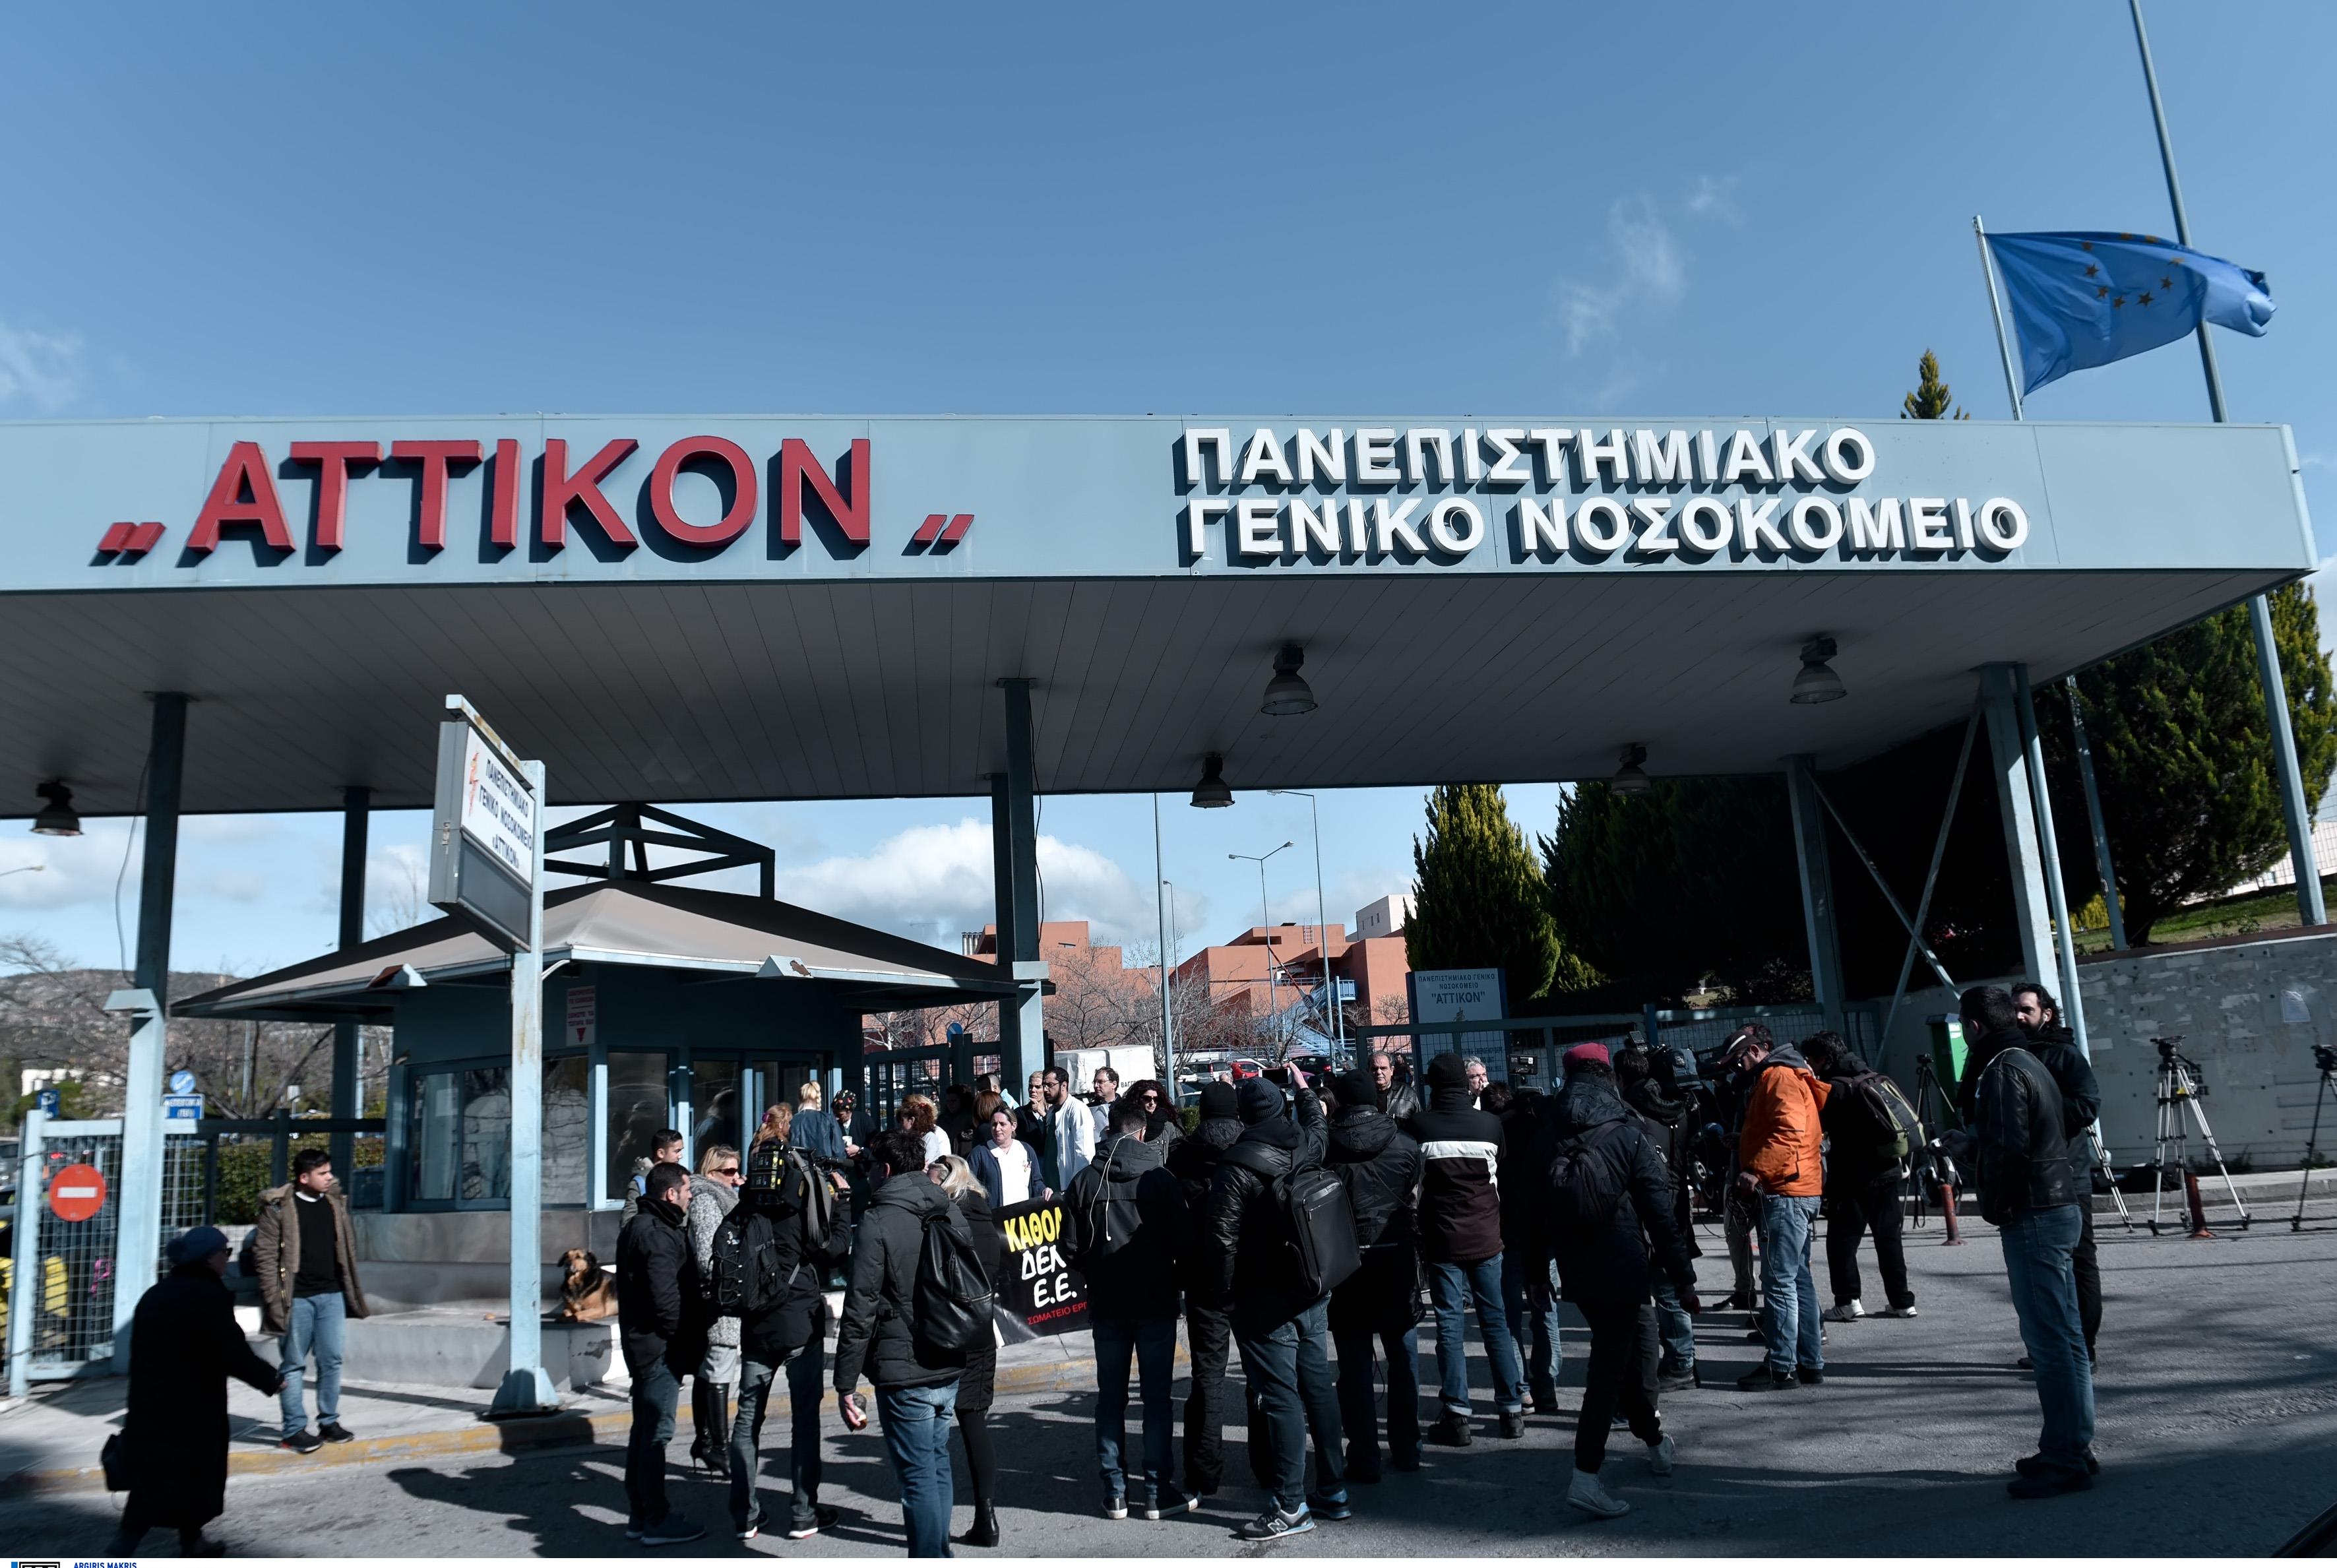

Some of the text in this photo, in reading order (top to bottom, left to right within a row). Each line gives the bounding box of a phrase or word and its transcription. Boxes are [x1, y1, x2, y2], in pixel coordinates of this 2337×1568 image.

[1185, 426, 1875, 485] ΠΑΝΕΠΙΣΤΗΜΙΑΚΟ
[1189, 497, 2030, 555] ΓΕΝΙΚΟ ΝΟΣΟΚΟΜΕΙΟ
[479, 784, 499, 819] ΓΕΝΙΚΟ
[1028, 1305, 1071, 1326] ΣΩΜΑΤΕΙΟ
